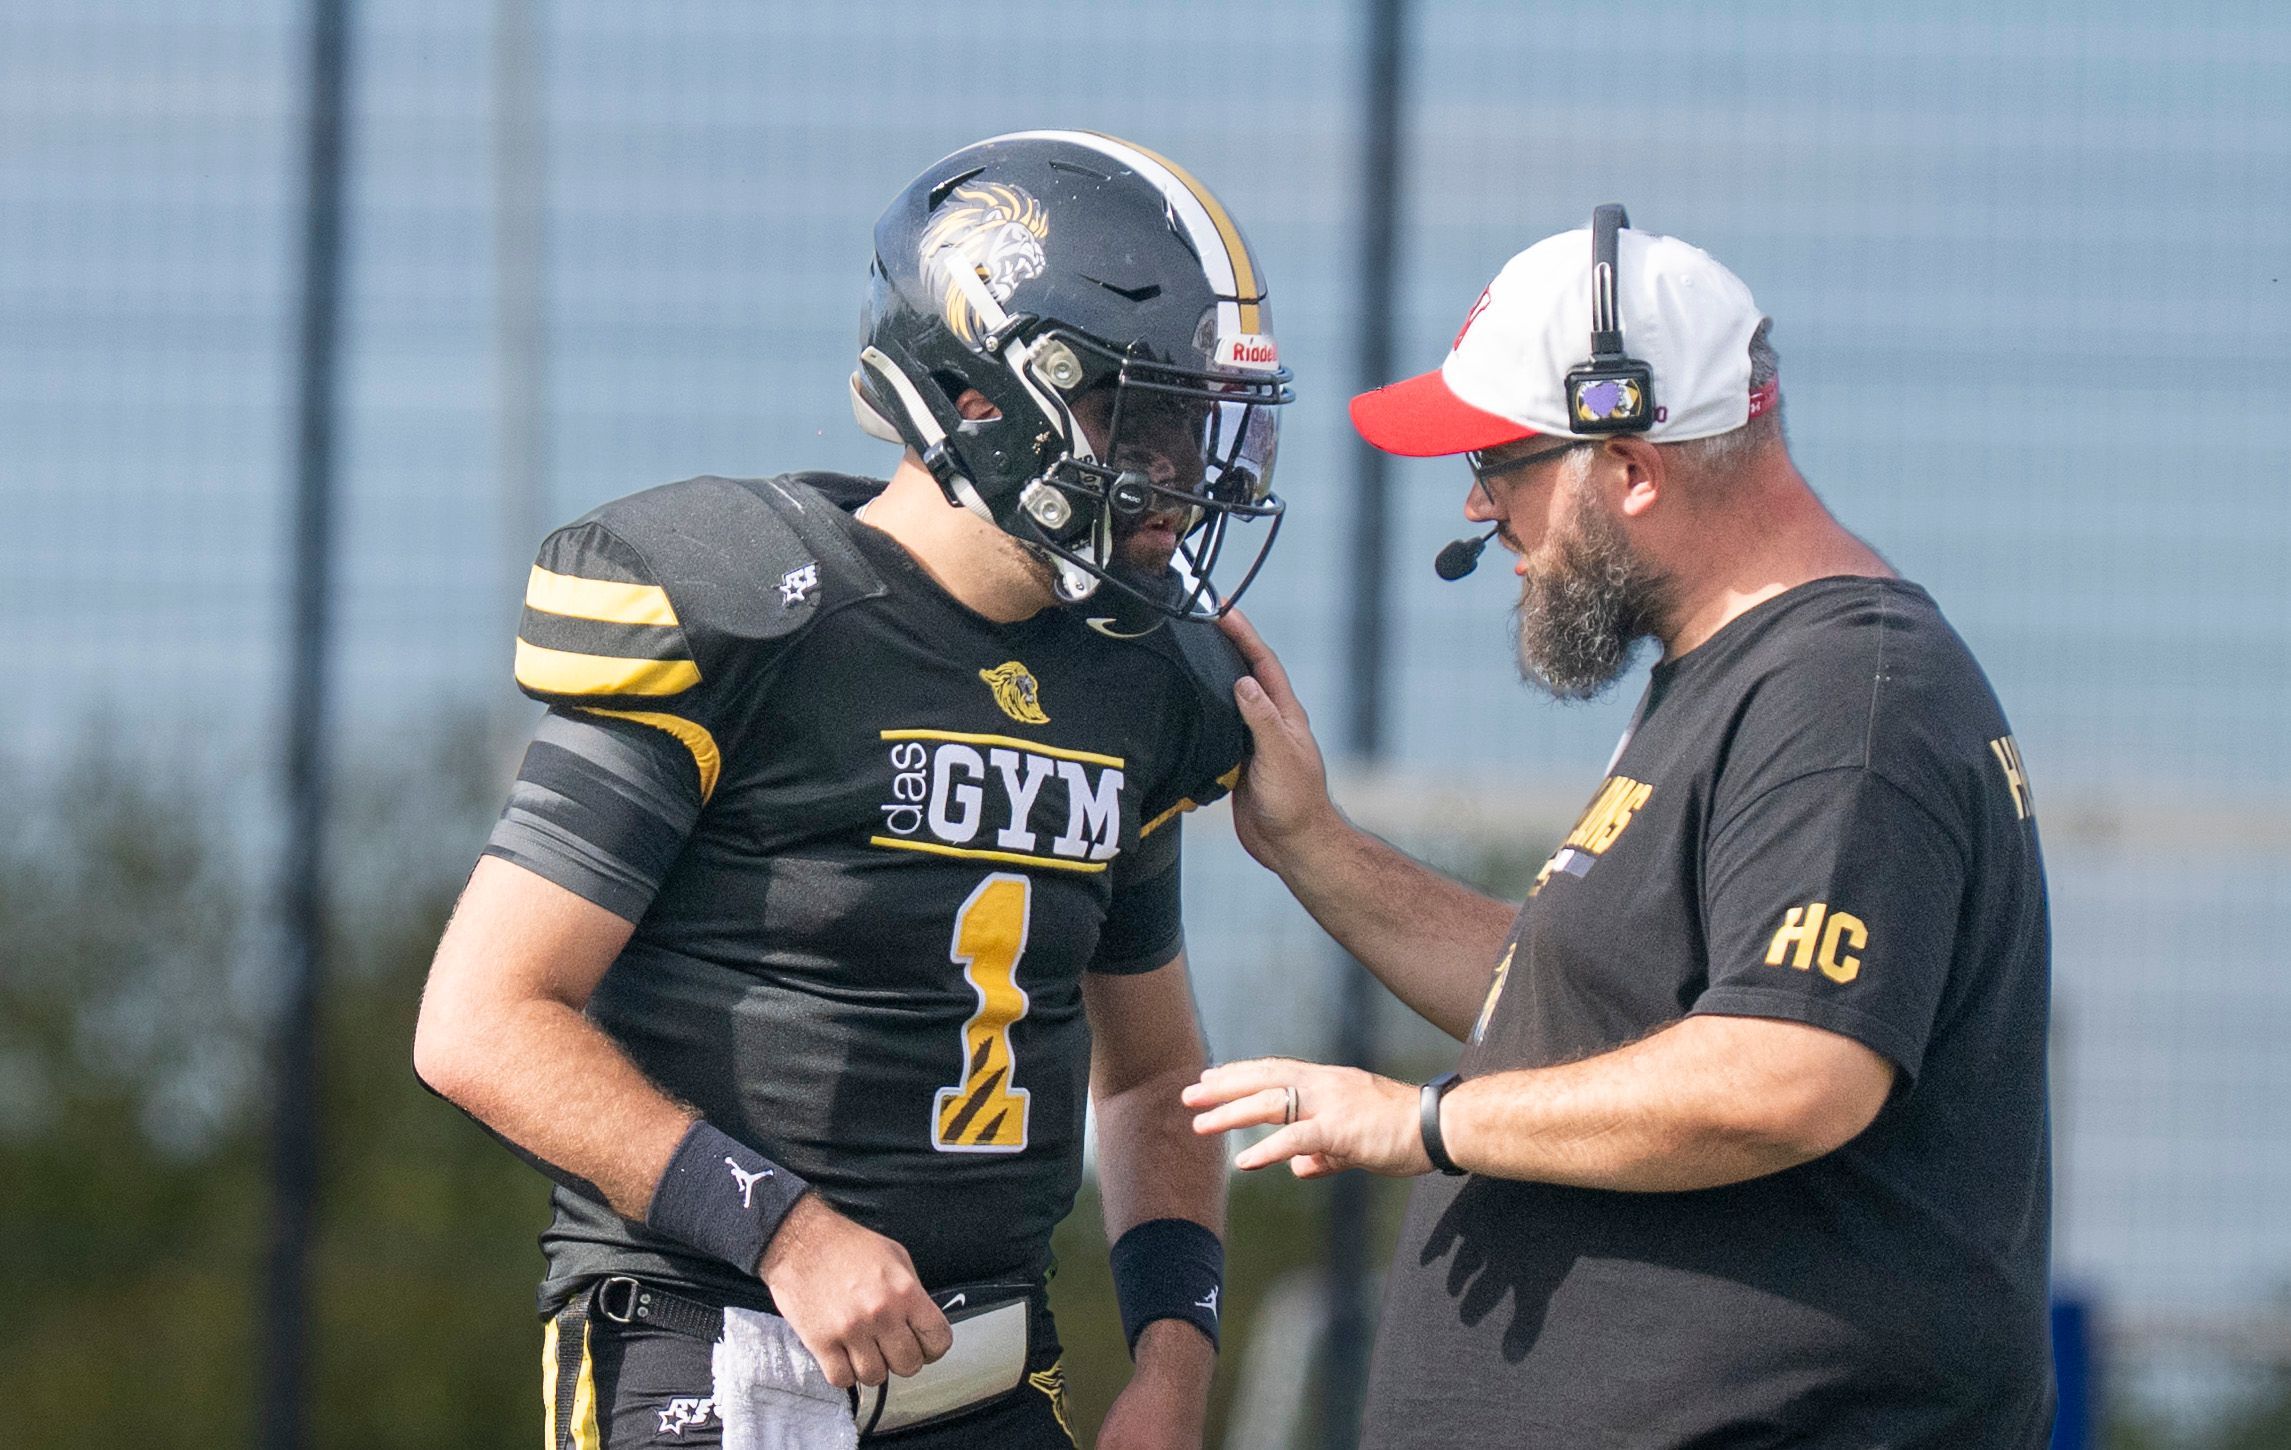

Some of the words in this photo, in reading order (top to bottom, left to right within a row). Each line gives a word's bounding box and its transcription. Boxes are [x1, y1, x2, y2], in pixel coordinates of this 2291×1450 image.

[1233, 342, 1279, 362] Ridde
[880, 742, 927, 835] das
[928, 743, 1124, 860] GYM
[1764, 902, 1869, 985] HC
[931, 872, 1032, 1153] 1
